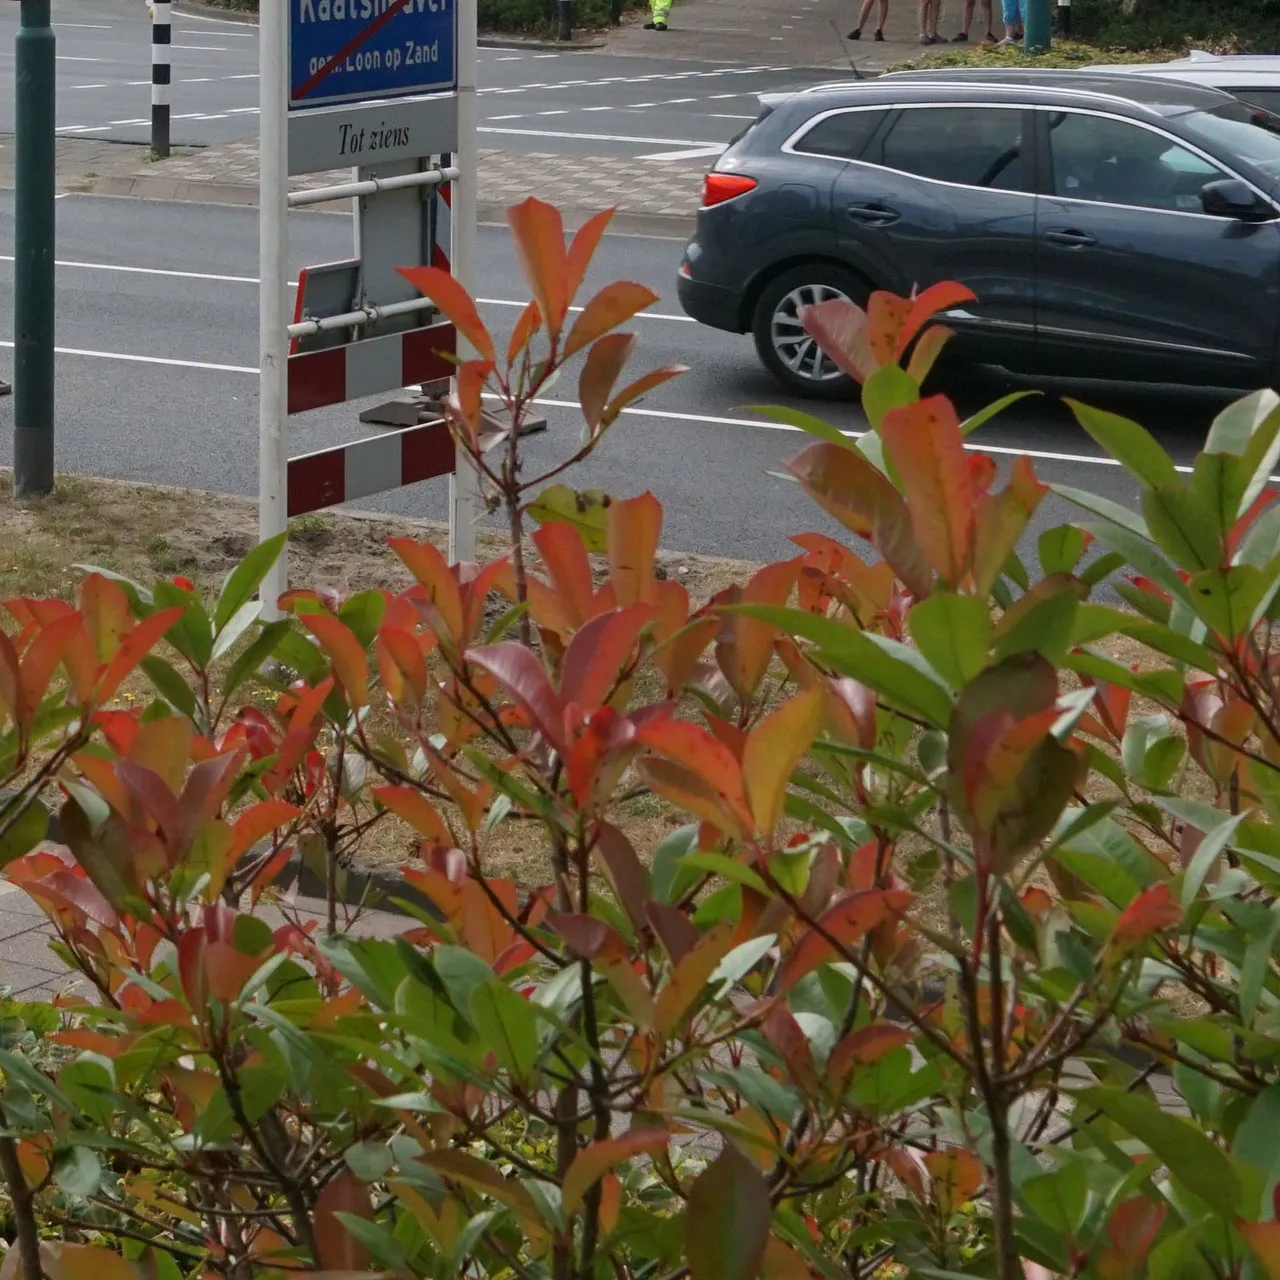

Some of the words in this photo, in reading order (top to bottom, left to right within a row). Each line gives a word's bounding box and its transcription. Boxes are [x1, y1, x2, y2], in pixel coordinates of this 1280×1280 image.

[346, 53, 381, 71] Loon
[385, 48, 401, 70] op
[405, 40, 438, 65] Zand
[339, 123, 364, 155] Tot
[369, 122, 409, 150] ziens
